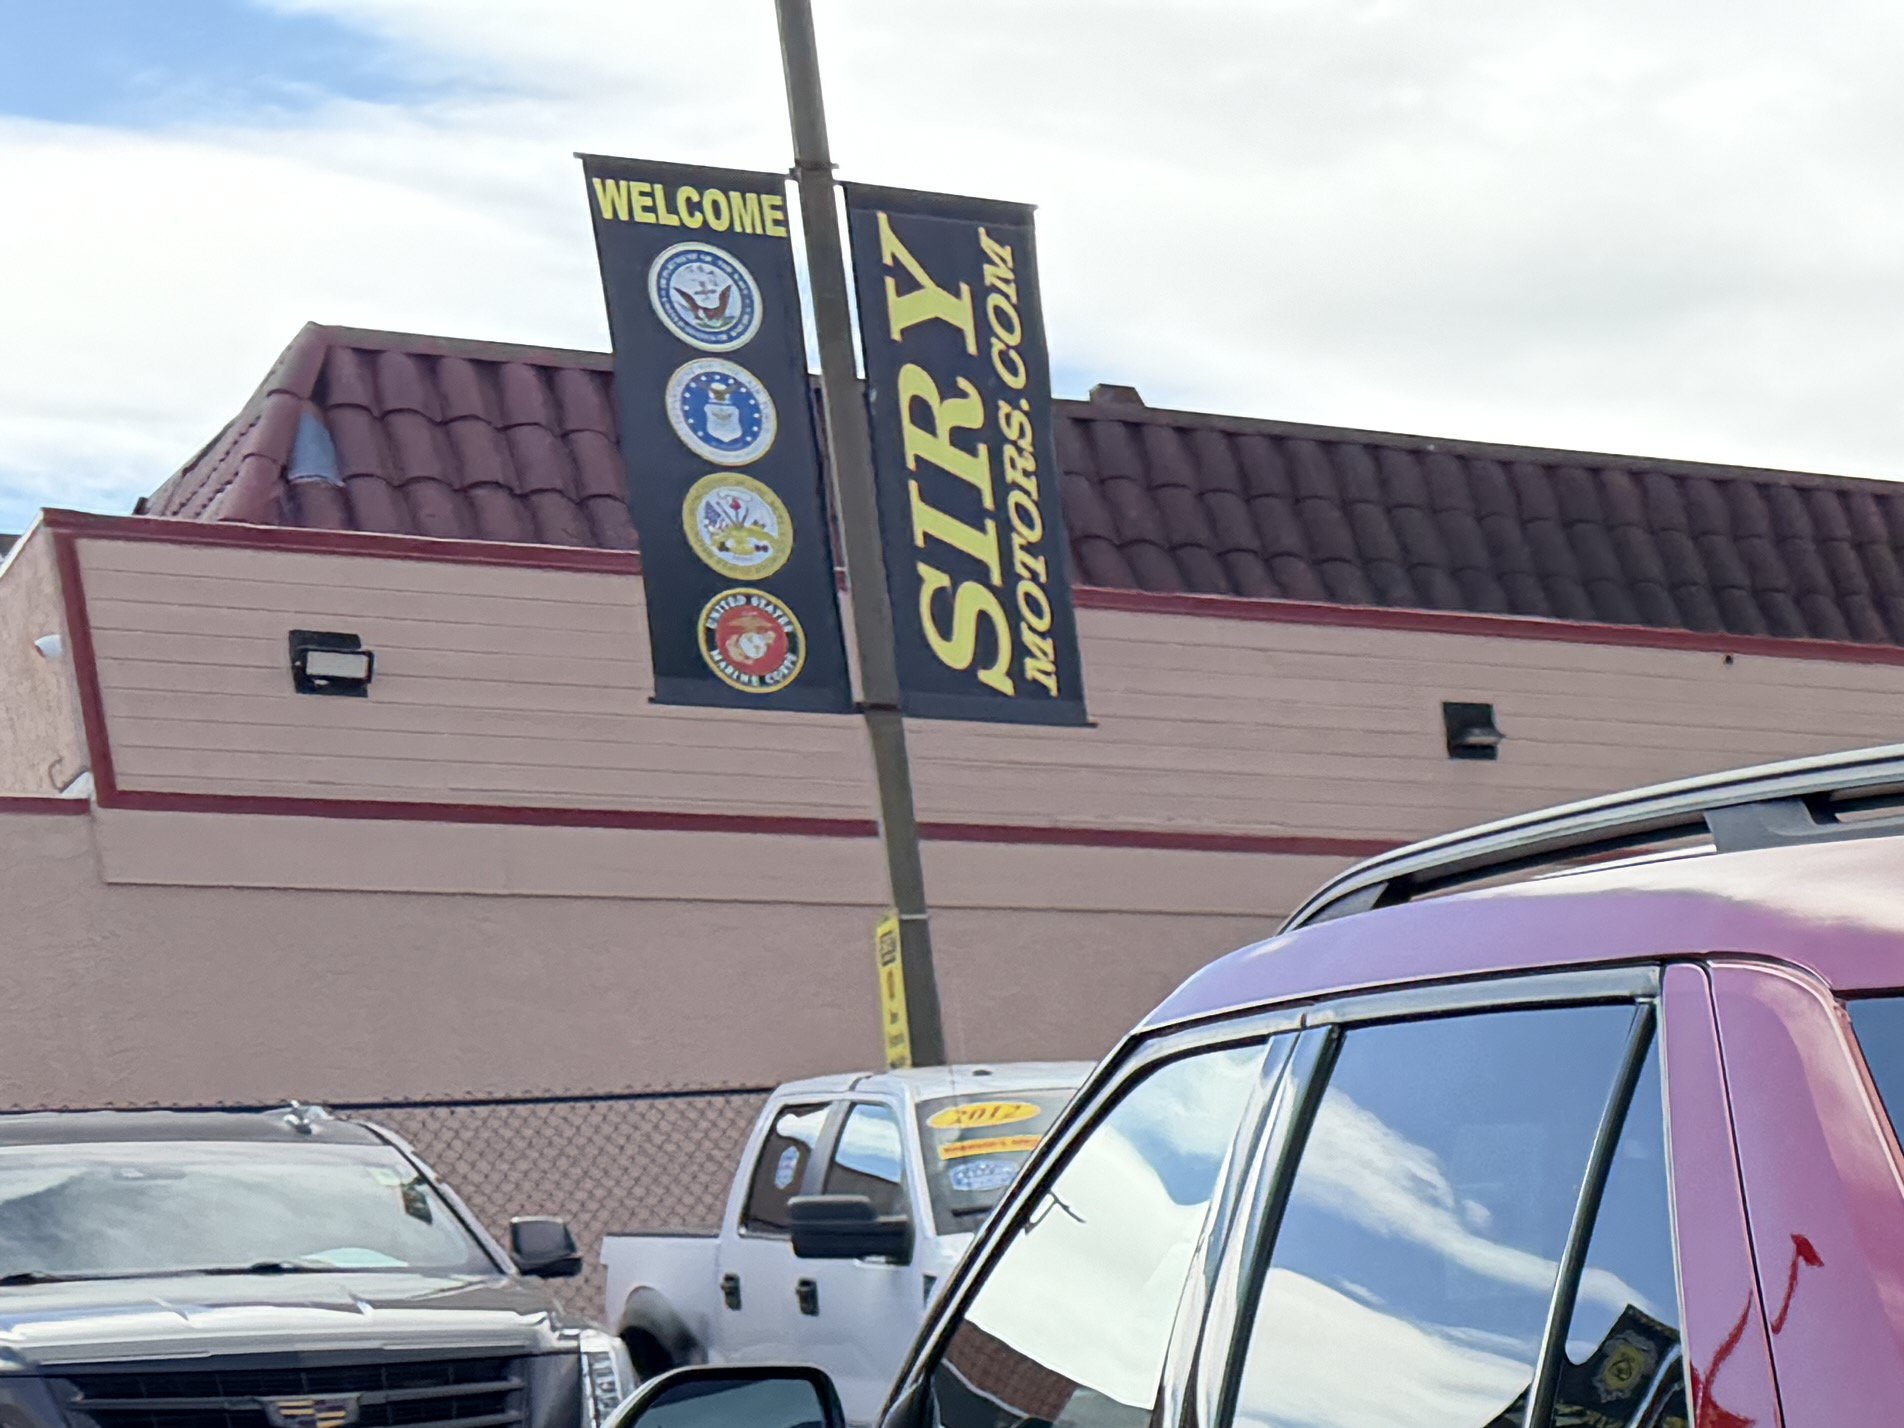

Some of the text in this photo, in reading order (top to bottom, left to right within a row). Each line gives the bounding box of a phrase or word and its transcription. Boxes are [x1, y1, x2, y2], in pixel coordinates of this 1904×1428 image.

[592, 177, 788, 238] WELCOME
[876, 209, 1015, 697] SIRY
[977, 226, 1058, 698] MOTORS.COM
